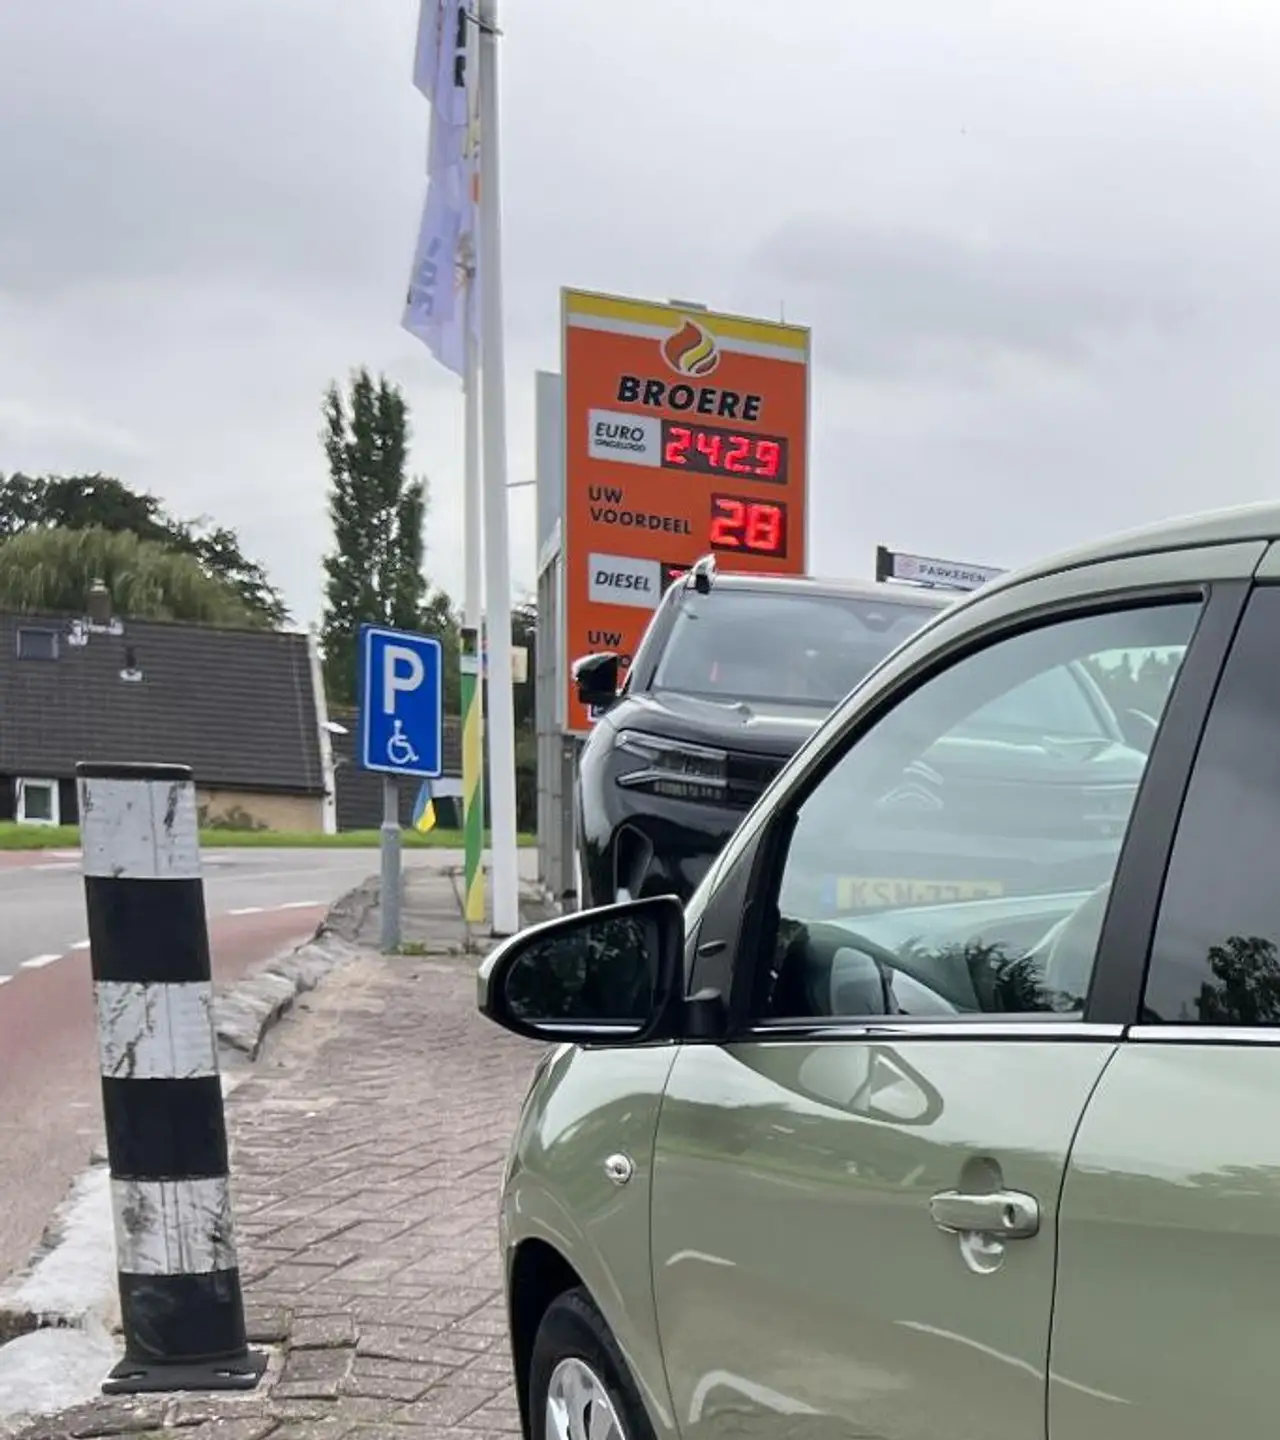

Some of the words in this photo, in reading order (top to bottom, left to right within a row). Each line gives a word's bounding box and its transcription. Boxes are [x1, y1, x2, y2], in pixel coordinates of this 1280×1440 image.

[616, 374, 762, 421] BROERE
[595, 421, 645, 442] EURO
[588, 485, 623, 505] UW
[590, 507, 692, 535] VOORDEEL
[710, 499, 781, 550] 28
[594, 570, 652, 592] DIESEL
[587, 629, 622, 649] UW
[383, 644, 425, 714] P
